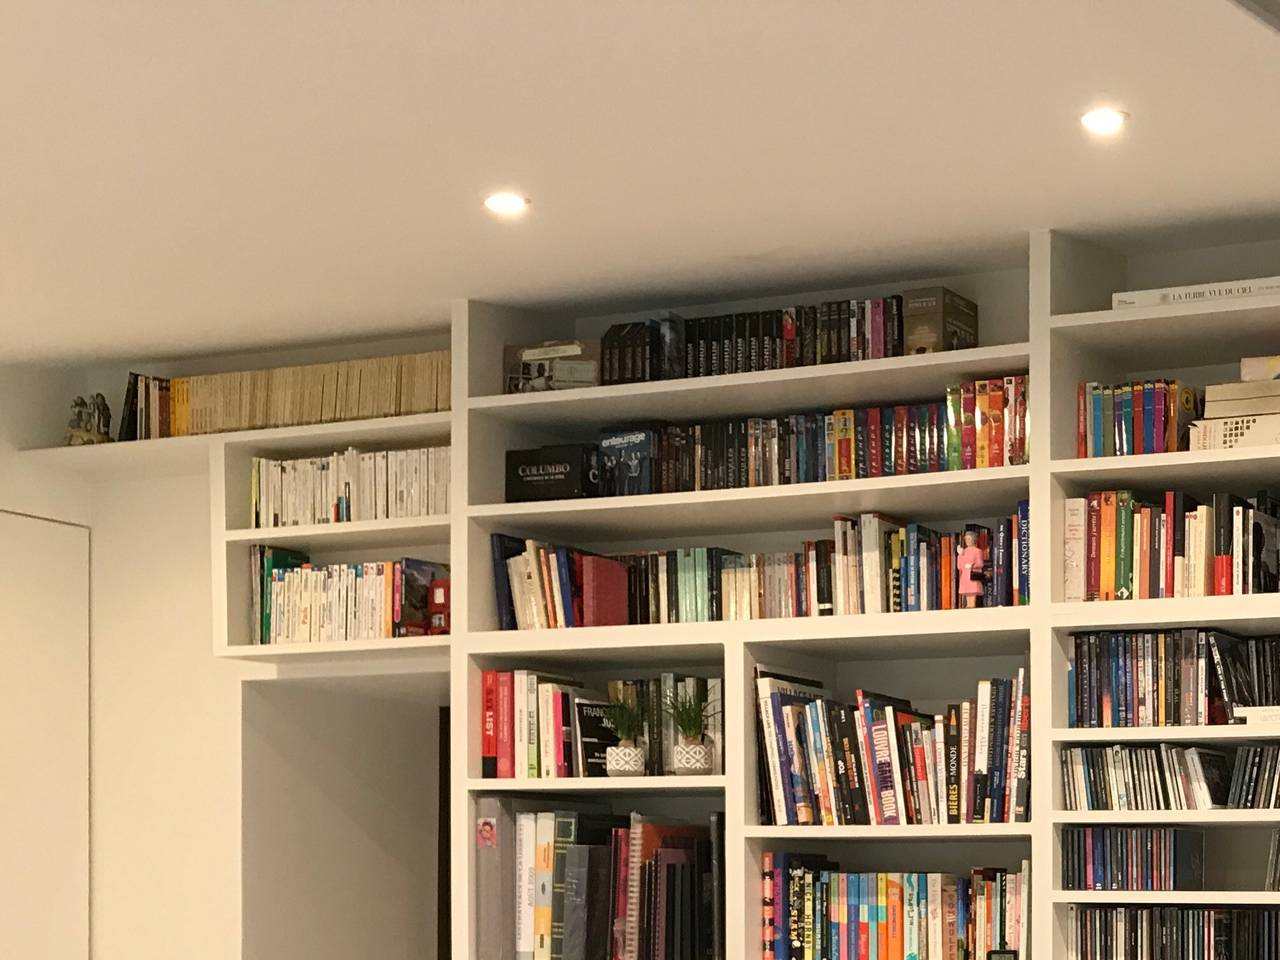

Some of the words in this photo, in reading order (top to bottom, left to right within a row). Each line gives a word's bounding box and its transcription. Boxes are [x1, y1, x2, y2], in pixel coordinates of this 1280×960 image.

[602, 431, 646, 448] entourage
[517, 463, 570, 478] COLUMBO
[873, 724, 890, 762] LOUVRE
[882, 791, 898, 818] BOOK
[949, 745, 957, 776] MONDE
[1018, 749, 1027, 779] Stars
[947, 784, 958, 816] BIÈRES
[790, 909, 799, 940] SLAM
